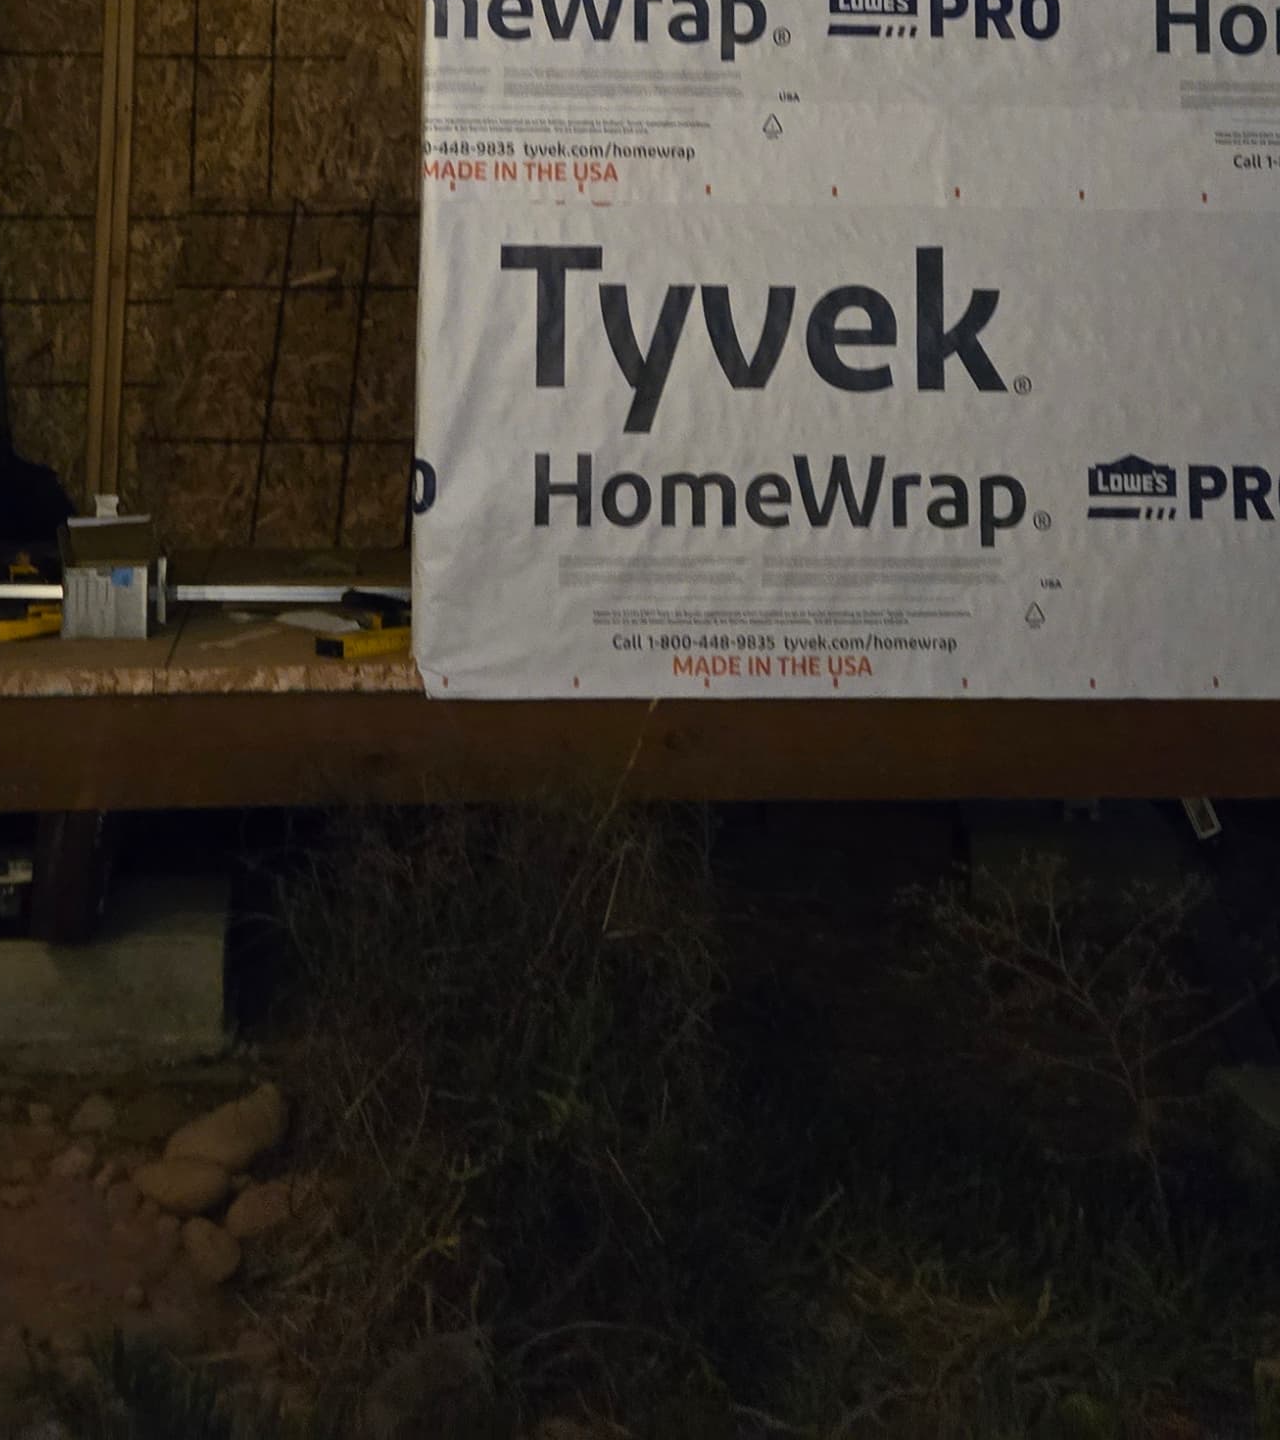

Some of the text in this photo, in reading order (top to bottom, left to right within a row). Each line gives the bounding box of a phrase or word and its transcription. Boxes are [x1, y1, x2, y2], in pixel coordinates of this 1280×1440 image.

[523, 141, 696, 161] tyvek.com/homewrap
[1233, 154, 1262, 169] Call
[424, 160, 618, 183] MADE IN THE USA
[1097, 469, 1169, 493] LOWE'S
[612, 633, 957, 654] Call 1-800-448-9835 tyvek.com/homewrap
[672, 655, 873, 677] MADE IN THE USA
